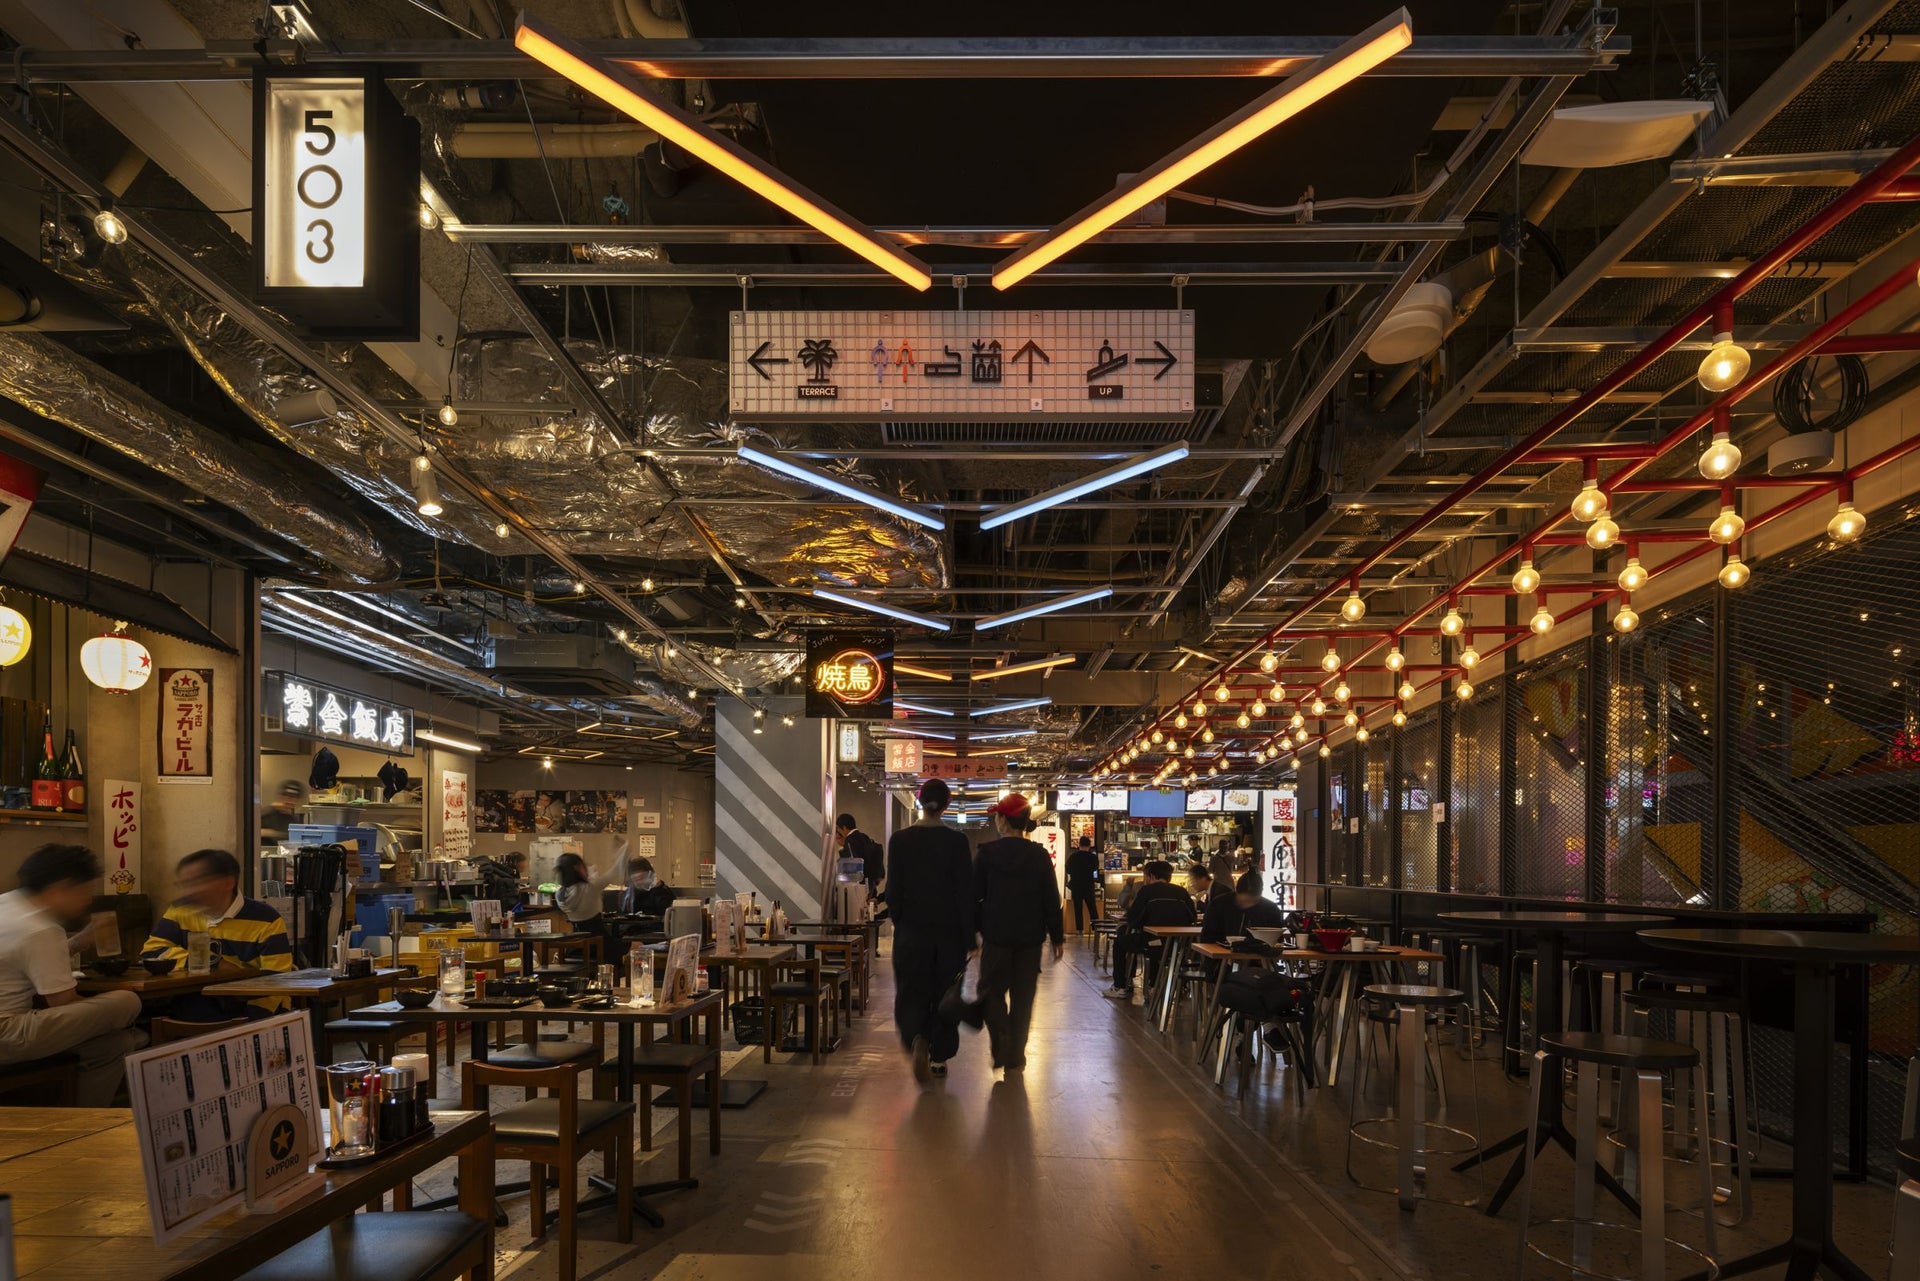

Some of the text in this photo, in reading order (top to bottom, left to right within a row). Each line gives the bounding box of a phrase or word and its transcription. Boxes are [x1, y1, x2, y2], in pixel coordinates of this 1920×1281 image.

[297, 110, 343, 264] 503
[800, 387, 836, 398] TERRACE
[1099, 387, 1113, 397] UP
[817, 662, 873, 691] 焼鳥
[194, 703, 204, 727] サッポロ
[176, 703, 194, 772] ラガービール
[111, 785, 137, 869] ホッピー
[265, 1154, 299, 1178] SAPPORO
